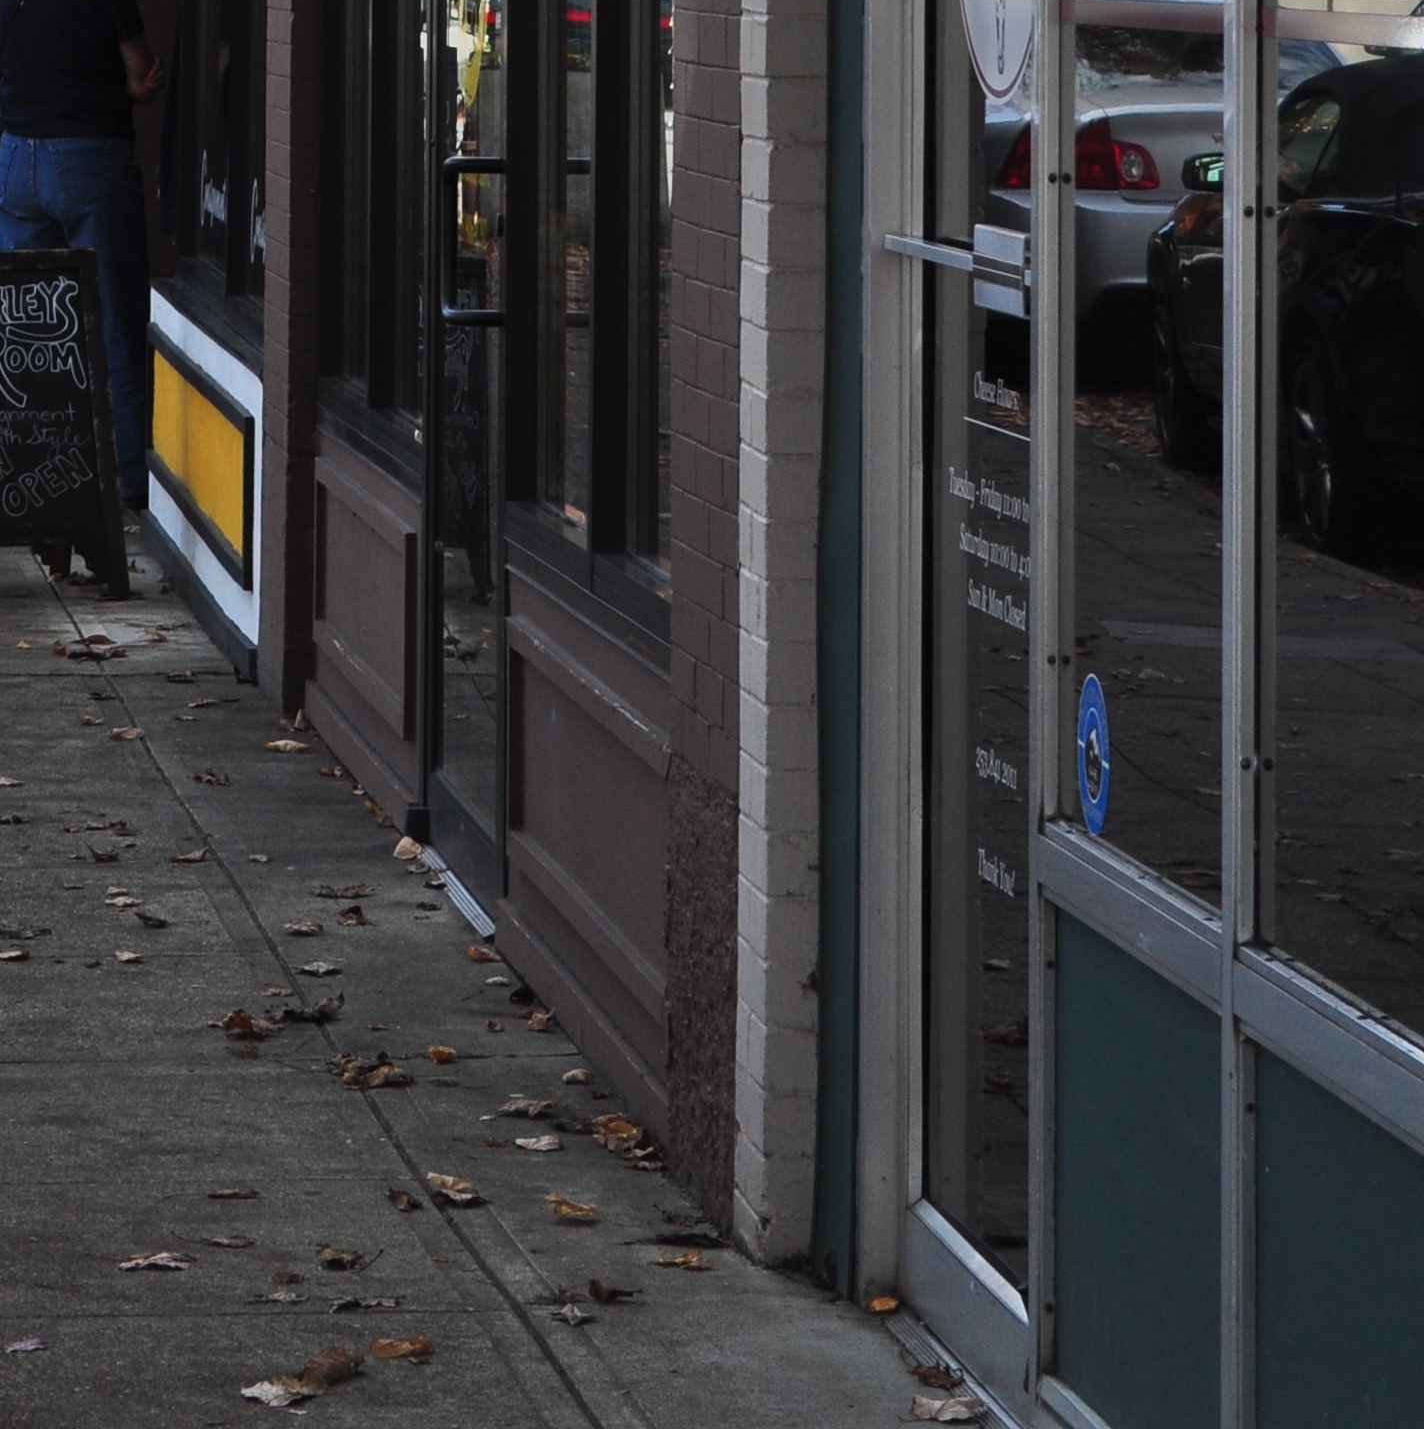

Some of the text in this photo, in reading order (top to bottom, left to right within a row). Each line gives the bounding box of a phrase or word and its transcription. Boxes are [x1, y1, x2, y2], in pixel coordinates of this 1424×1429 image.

[972, 369, 997, 405] Cheese
[2, 447, 94, 518] OPEN
[948, 465, 976, 510] Tuesday
[979, 477, 1003, 521] Friday
[959, 521, 990, 568] Saturday
[967, 578, 982, 612] Sun
[988, 586, 1004, 622] Mon
[1004, 594, 1027, 632] Closed
[977, 847, 1000, 888] Thank
